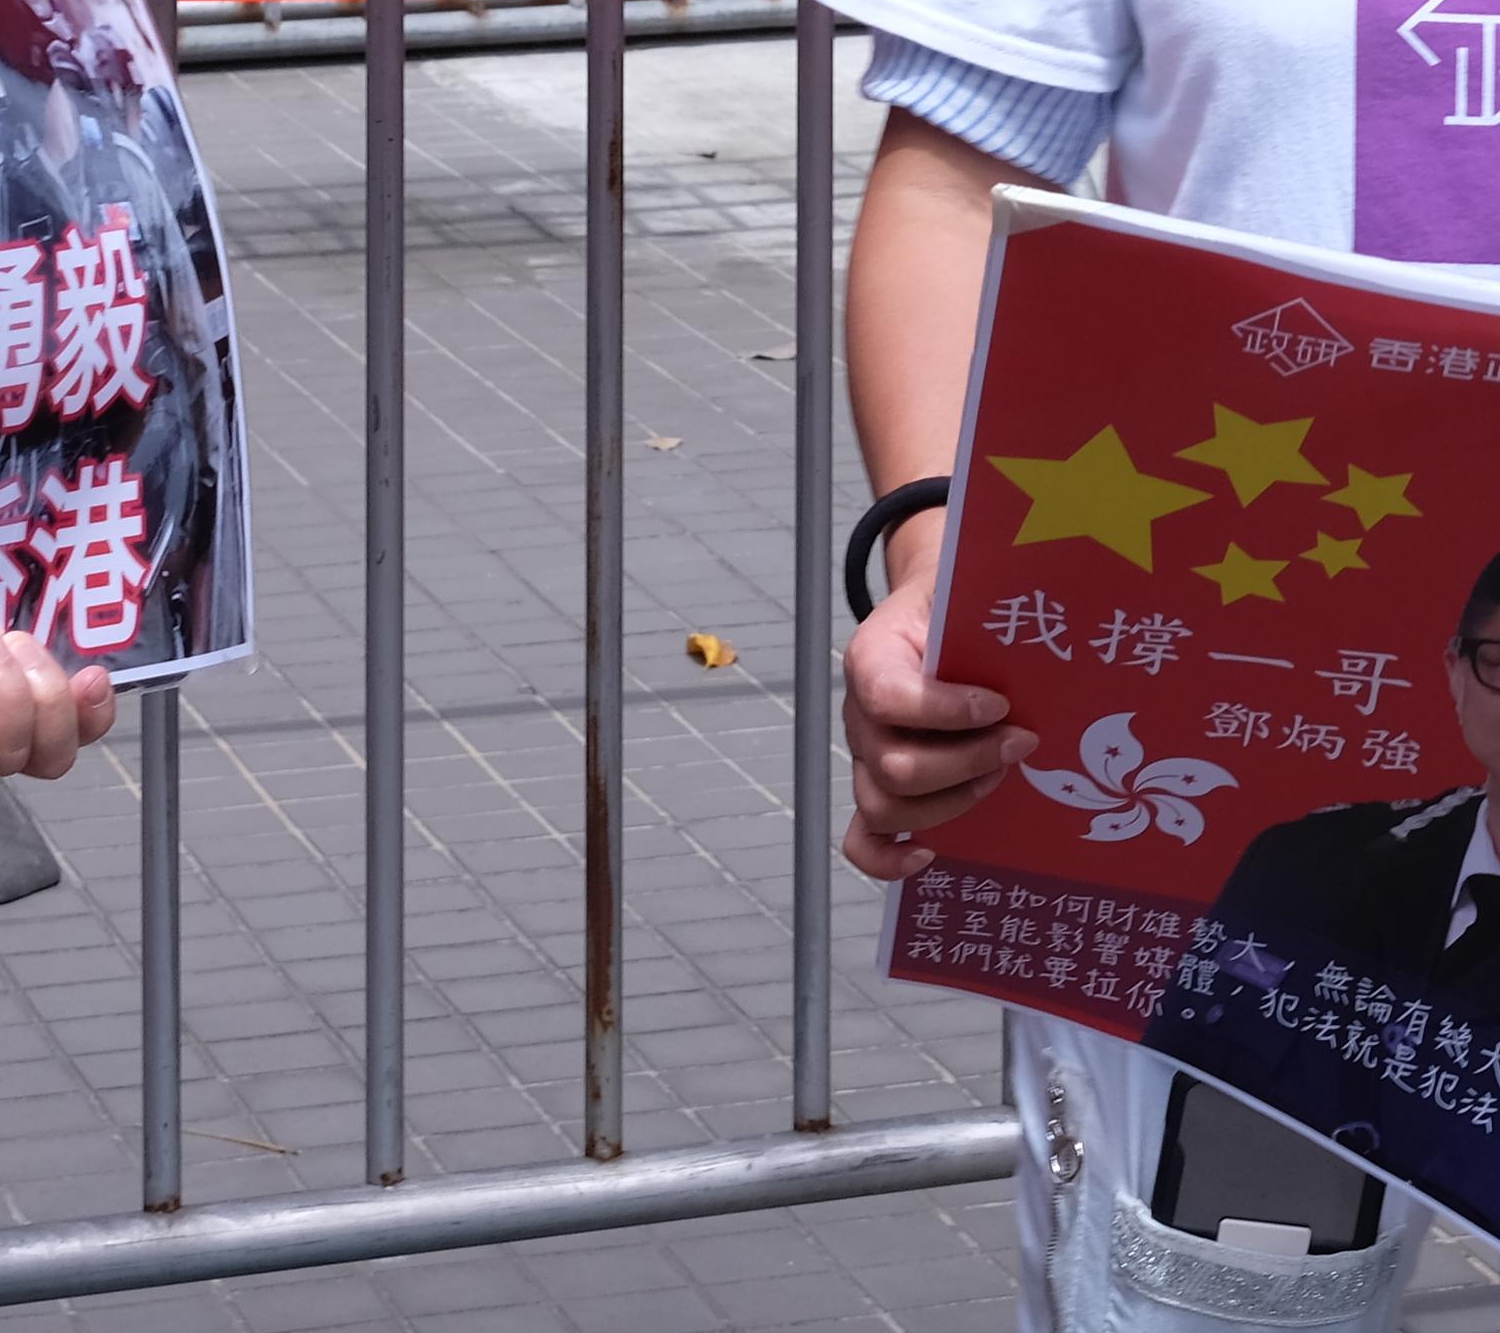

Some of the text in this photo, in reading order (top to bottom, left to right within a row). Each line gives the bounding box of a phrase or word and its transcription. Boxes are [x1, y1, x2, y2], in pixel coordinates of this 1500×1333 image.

[982, 589, 1413, 716] 我撐一哥
[1205, 701, 1422, 775] 鄧炳強
